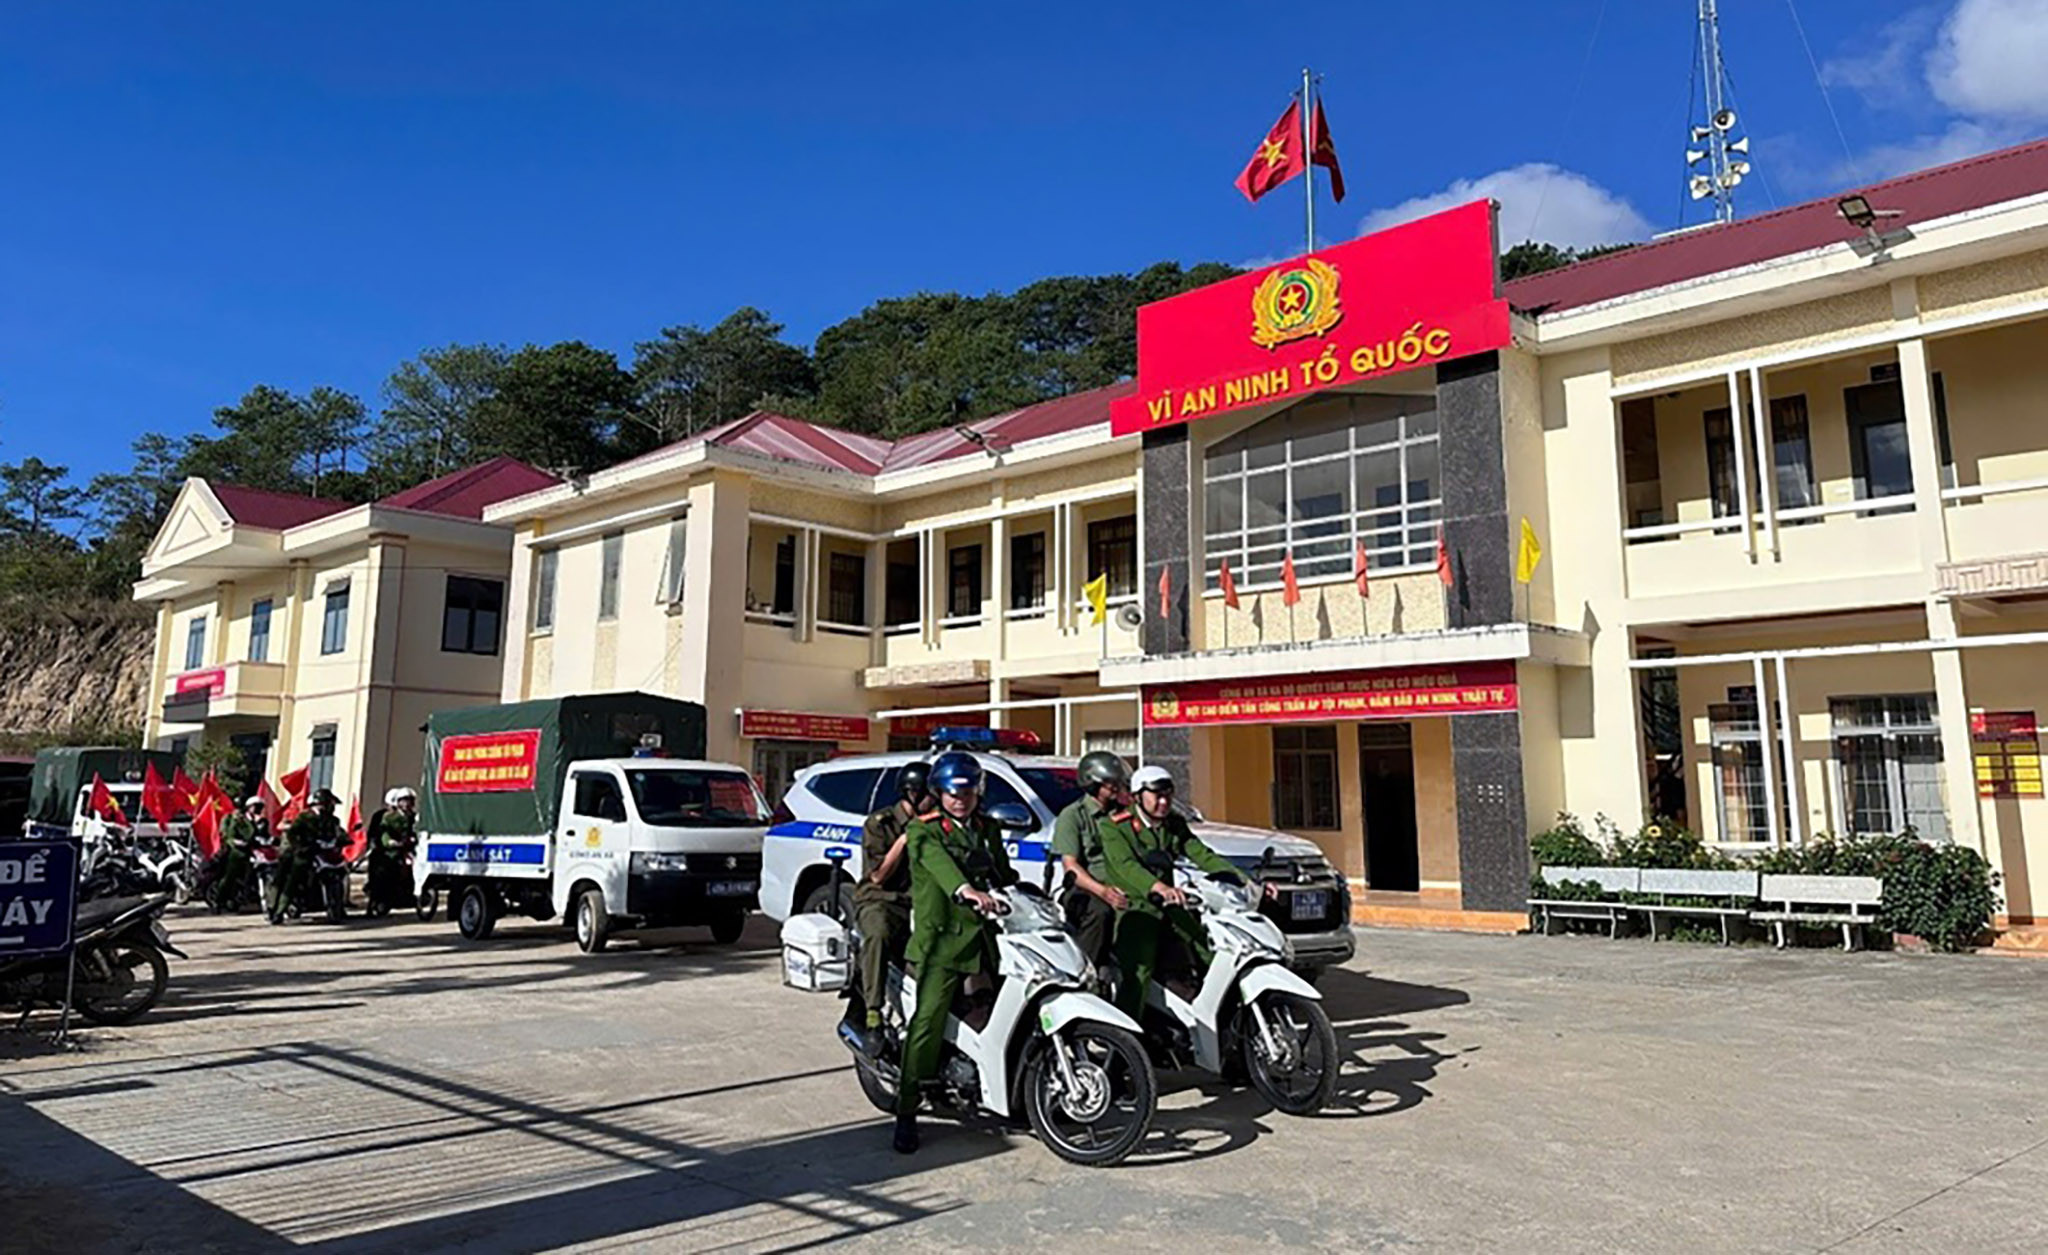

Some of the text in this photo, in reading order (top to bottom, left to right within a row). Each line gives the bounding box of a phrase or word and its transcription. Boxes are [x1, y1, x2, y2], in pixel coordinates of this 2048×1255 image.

[1148, 321, 1450, 422] VÌ AN NINH TỔ QUỐC
[0, 896, 54, 926] ÁY
